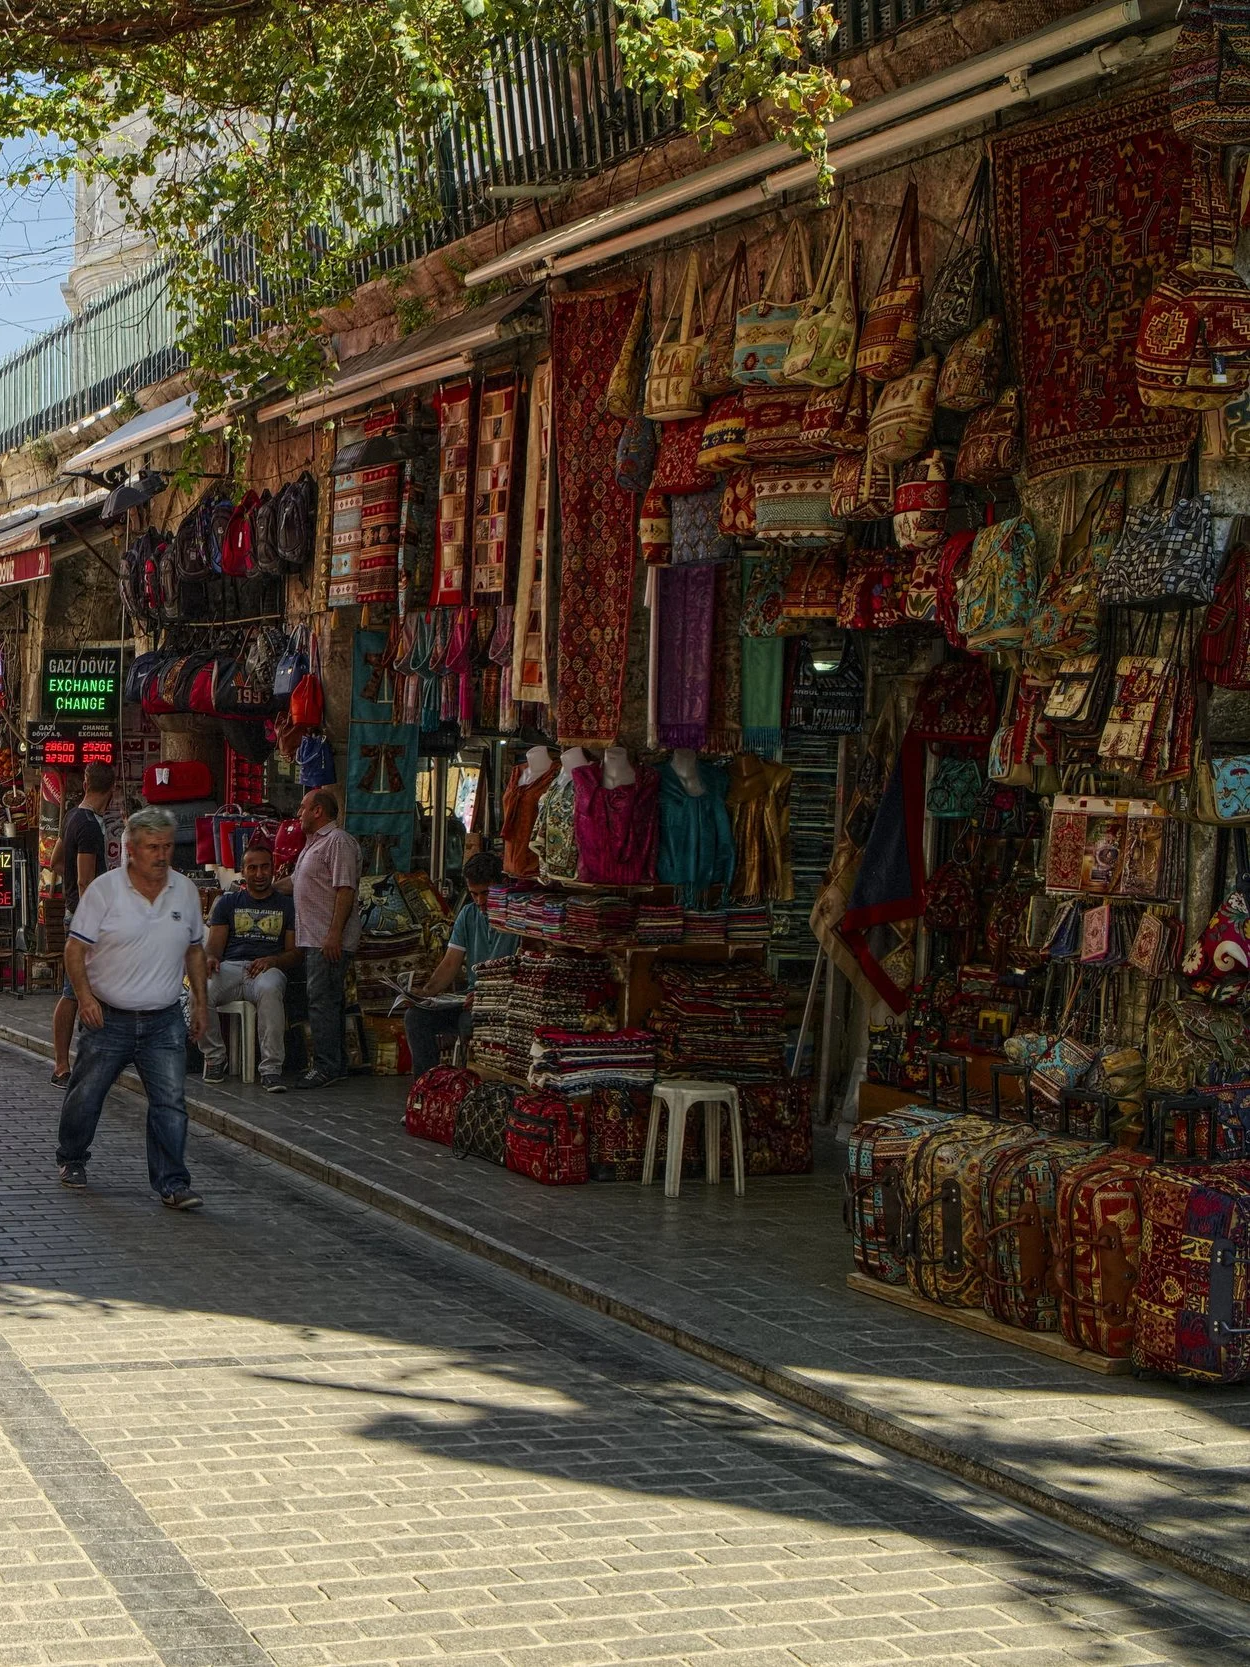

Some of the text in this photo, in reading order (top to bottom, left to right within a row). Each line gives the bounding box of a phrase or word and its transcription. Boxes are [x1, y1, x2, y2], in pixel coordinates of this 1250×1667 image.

[50, 656, 116, 674] GAZİ DÖVİZ
[50, 679, 114, 692] EXCHANGE
[56, 697, 105, 710] CHANGE
